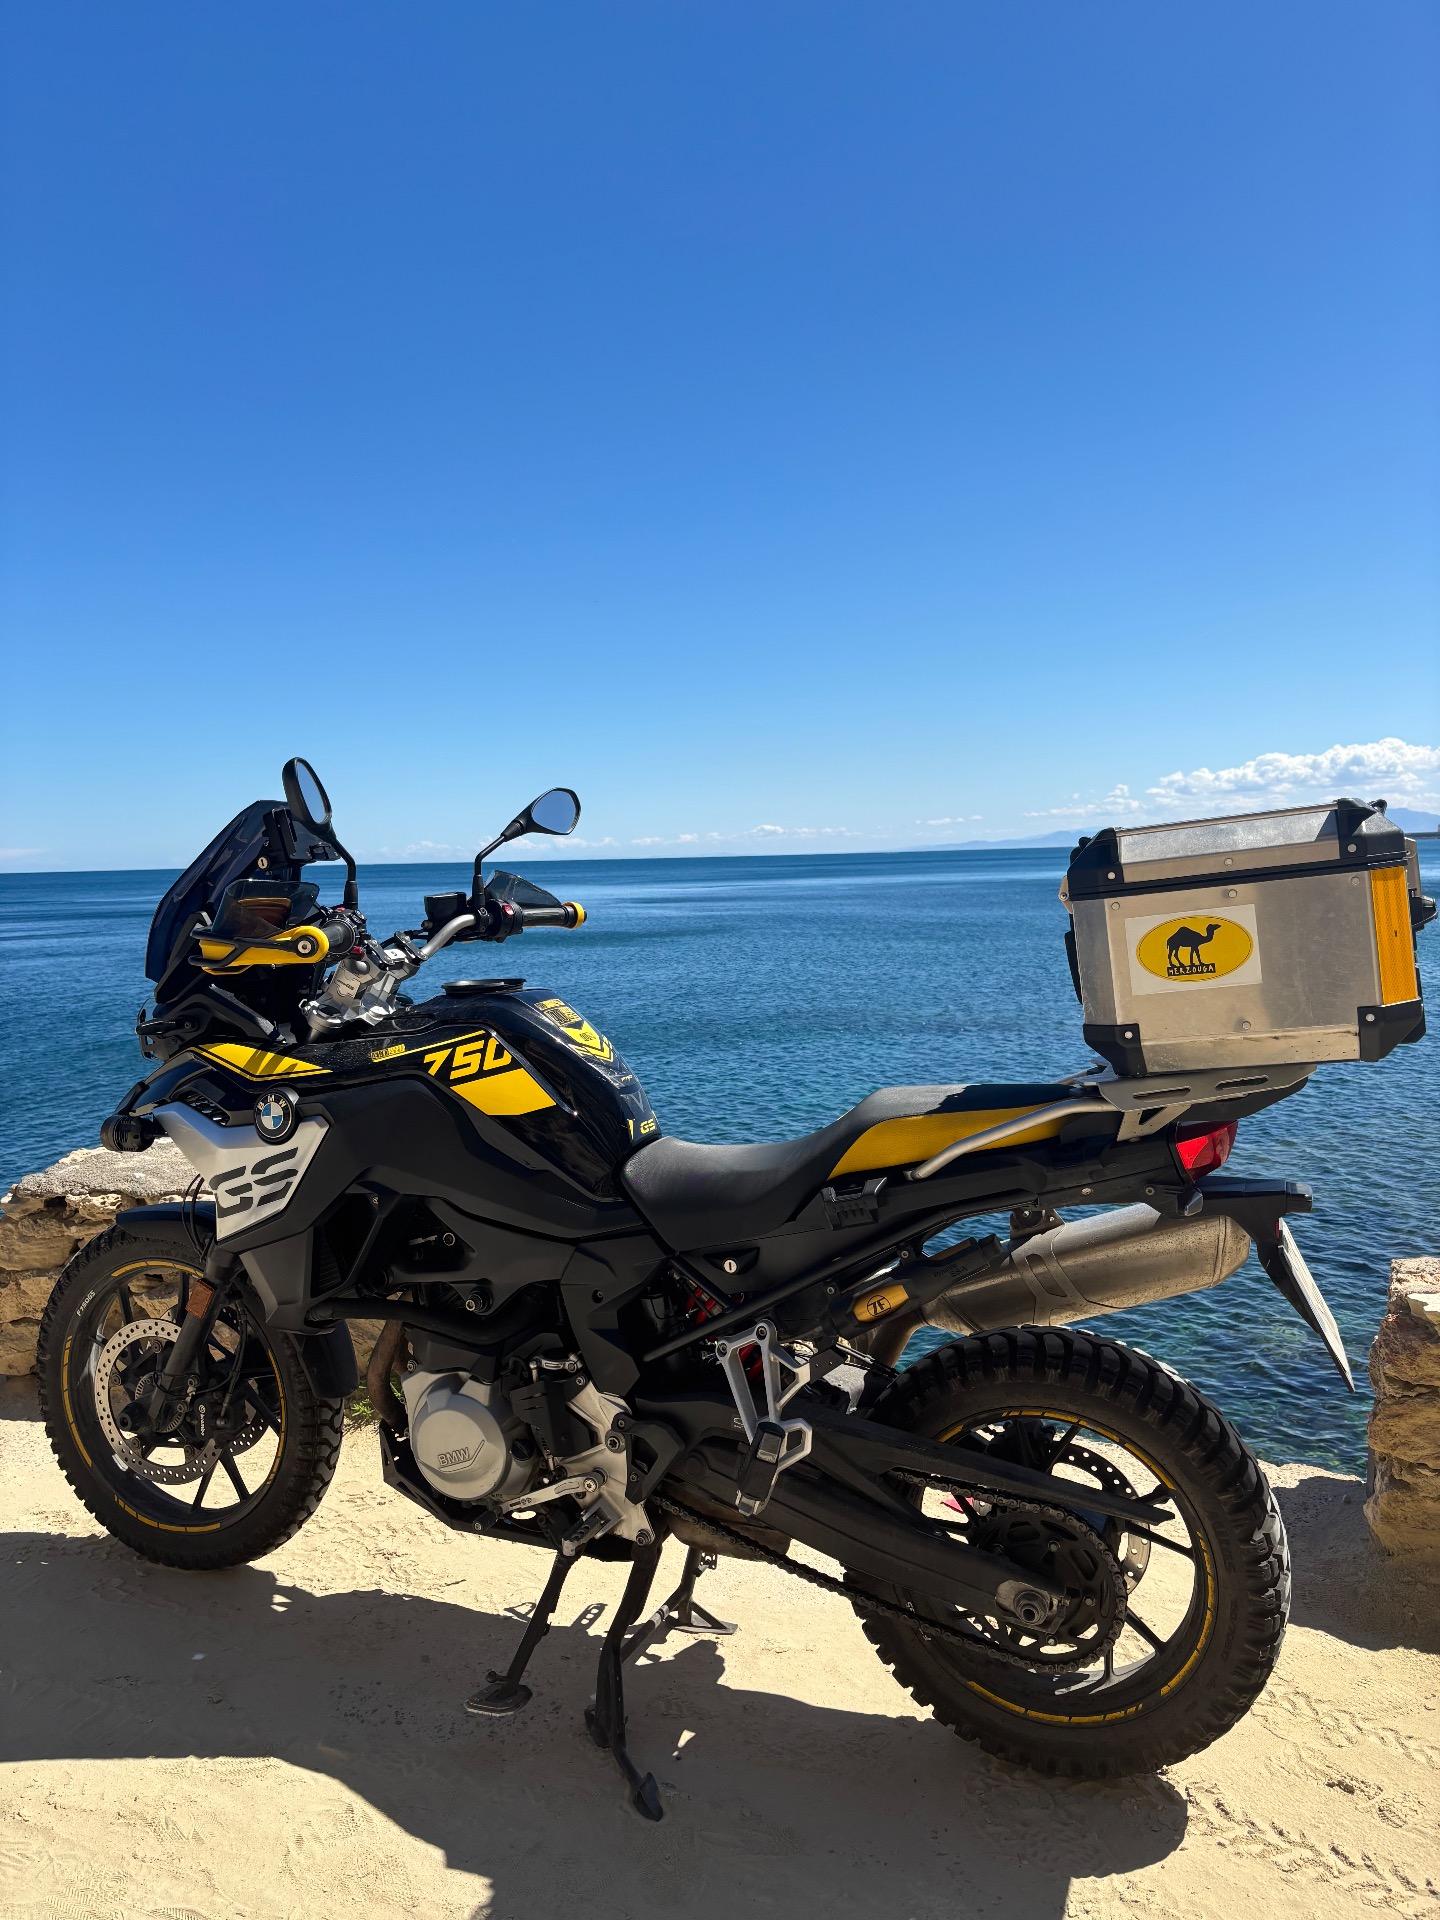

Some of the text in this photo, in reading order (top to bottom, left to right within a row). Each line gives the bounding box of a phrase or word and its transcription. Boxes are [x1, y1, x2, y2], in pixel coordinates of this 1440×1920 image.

[257, 1094, 287, 1112] BMW
[640, 1118, 656, 1135] GS
[208, 1147, 299, 1218] GS
[438, 1446, 470, 1466] BMW
